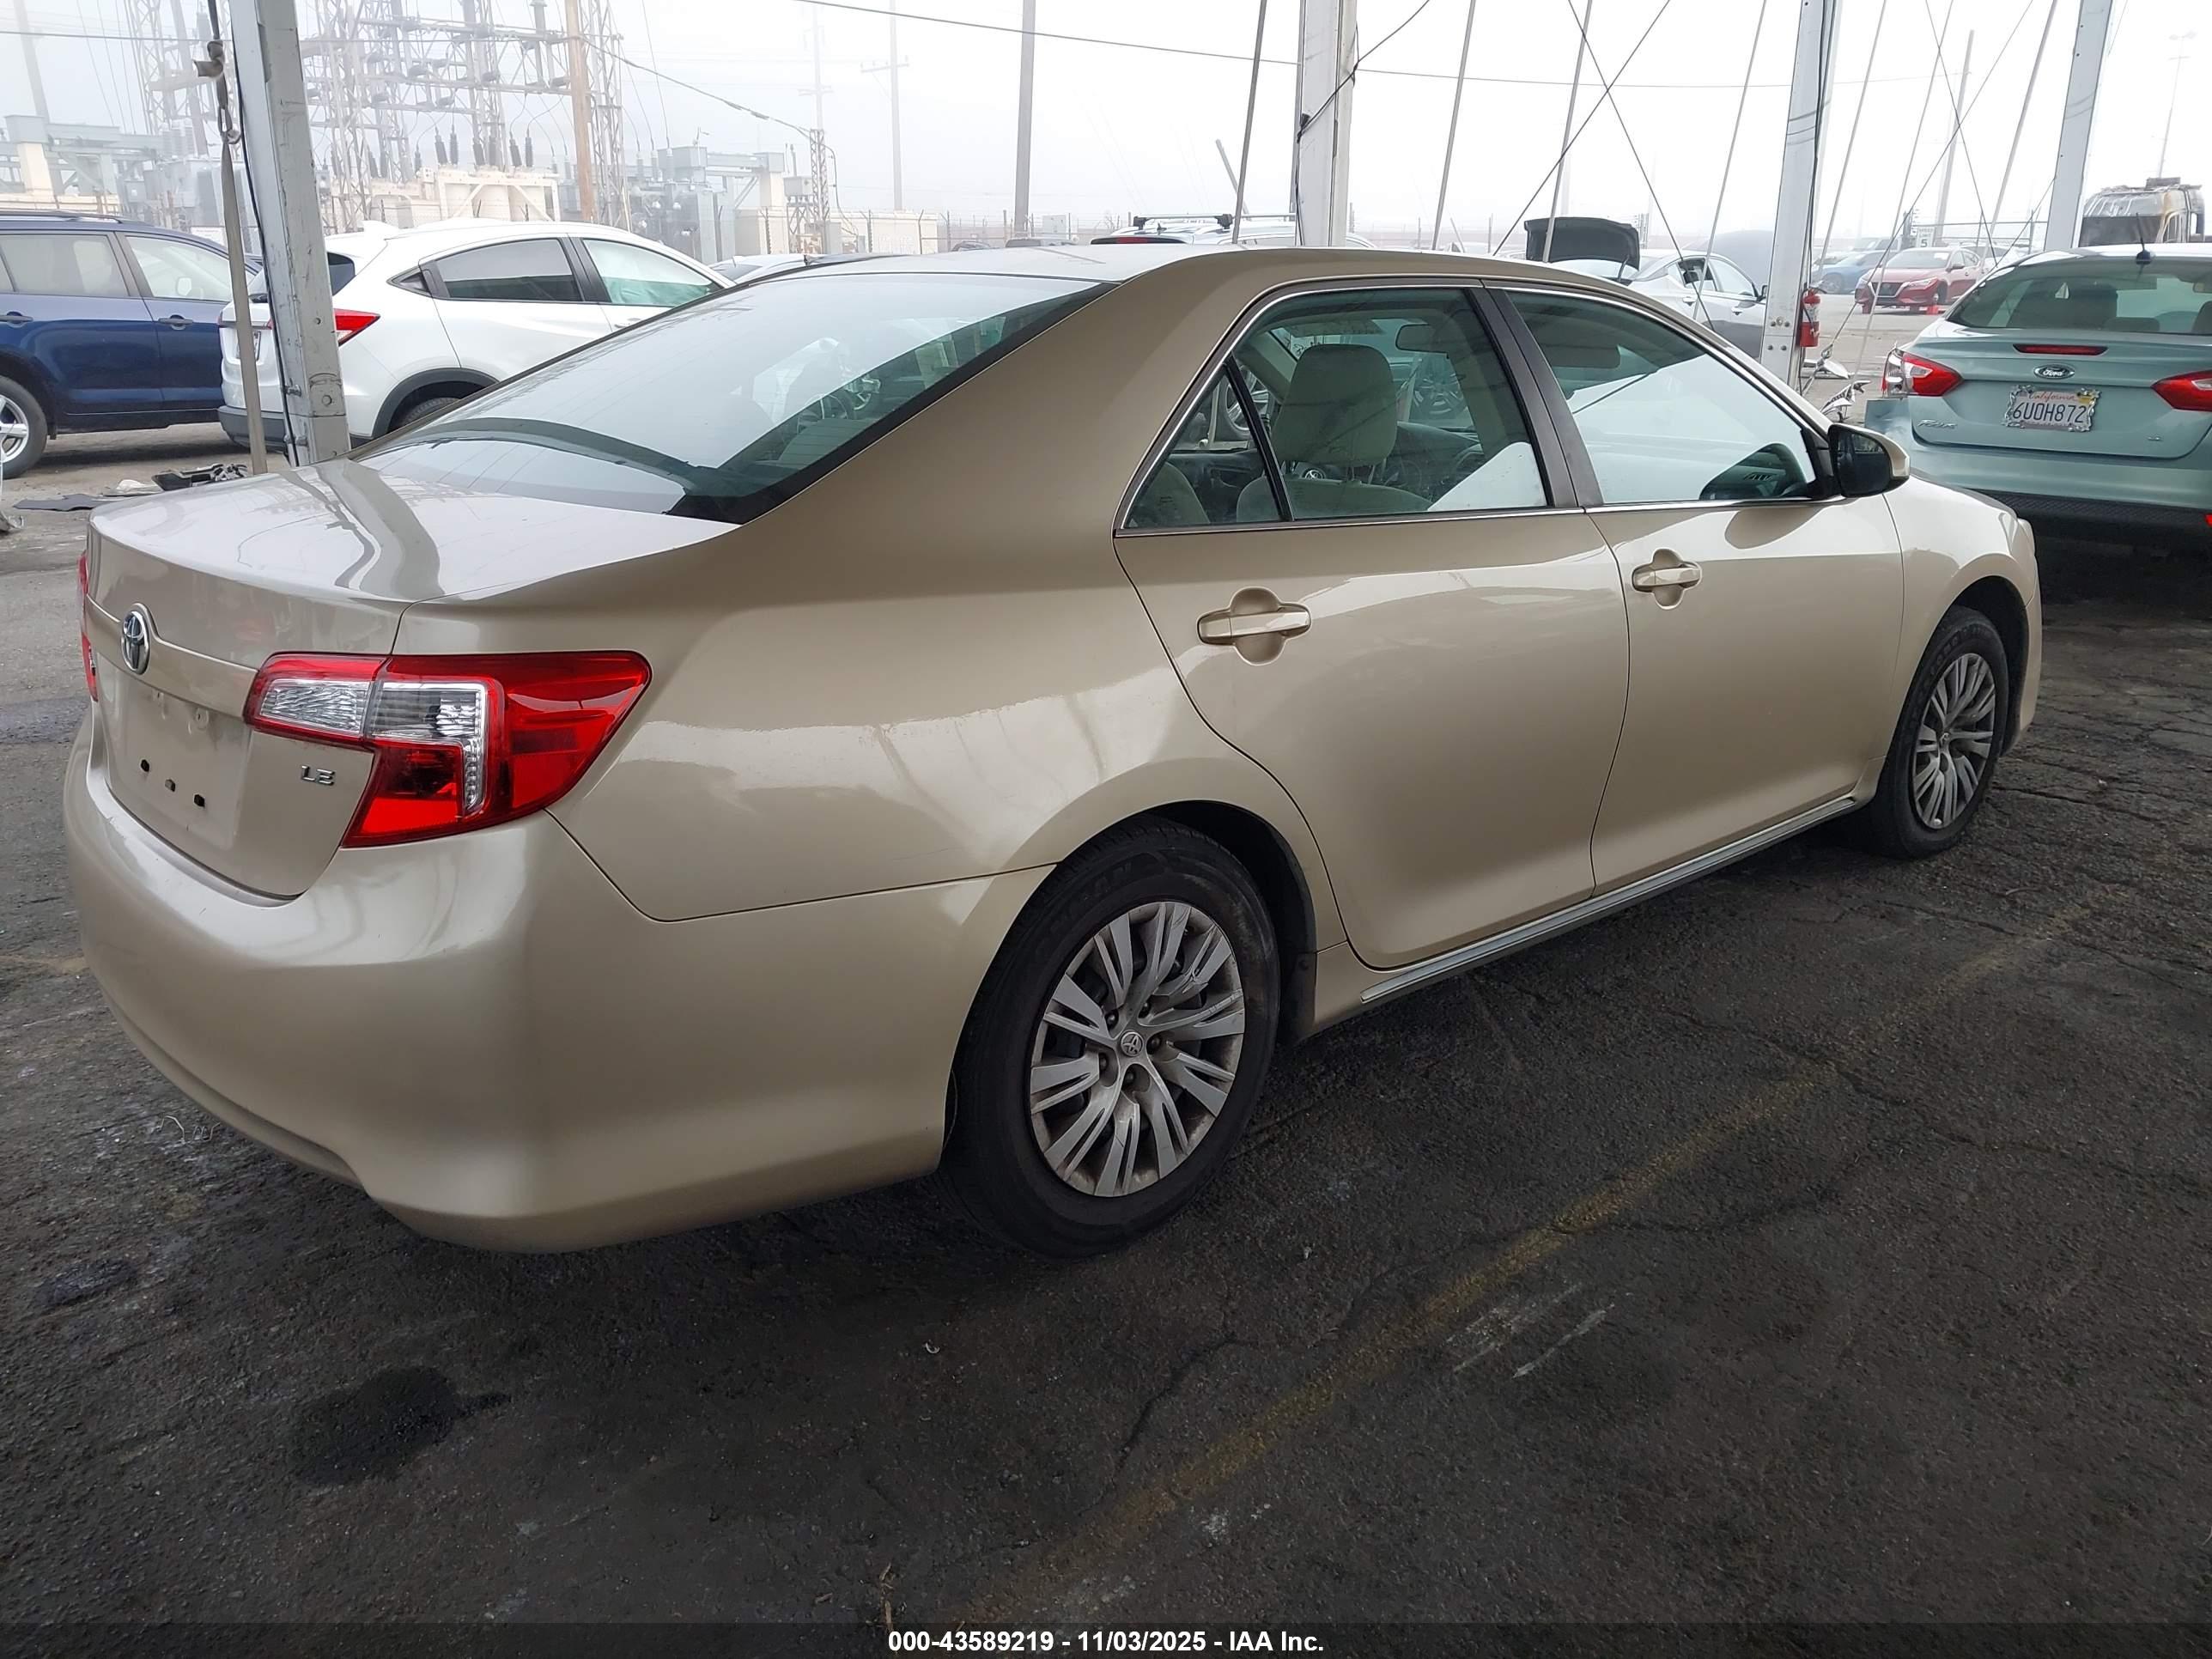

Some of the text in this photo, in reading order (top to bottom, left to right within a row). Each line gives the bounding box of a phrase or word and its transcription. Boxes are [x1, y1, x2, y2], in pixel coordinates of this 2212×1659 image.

[1920, 239, 1928, 247] 5
[2028, 392, 2076, 403] California
[301, 765, 335, 786] LE
